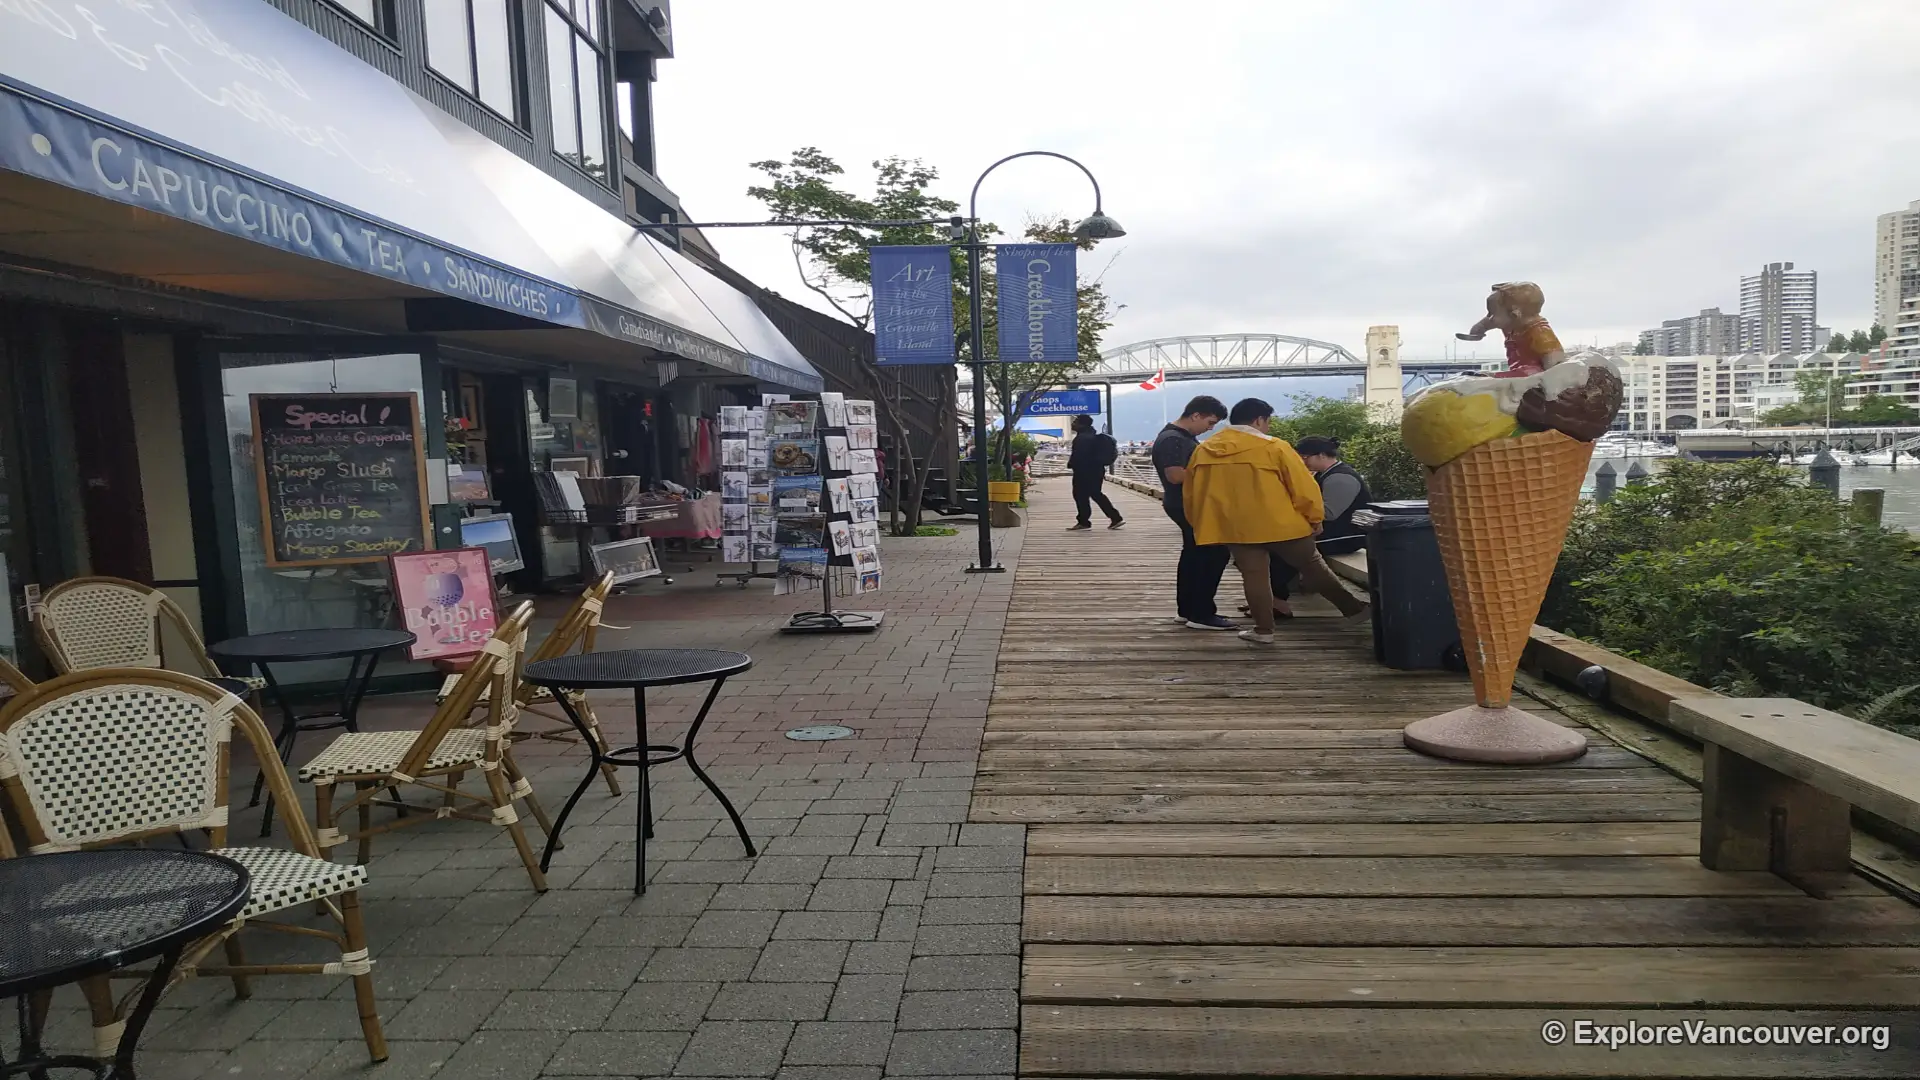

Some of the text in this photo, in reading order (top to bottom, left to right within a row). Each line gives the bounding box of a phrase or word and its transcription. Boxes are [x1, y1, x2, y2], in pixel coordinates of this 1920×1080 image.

[1002, 246, 1037, 259] Shops
[1040, 246, 1053, 261] of
[885, 263, 936, 283] Art
[889, 305, 940, 318] Heart of
[1027, 259, 1053, 361] Creekhouse
[884, 322, 939, 333] Granville
[898, 339, 934, 349] Island
[1030, 403, 1089, 413] Creekhouse
[281, 505, 382, 523] Bubble Tea
